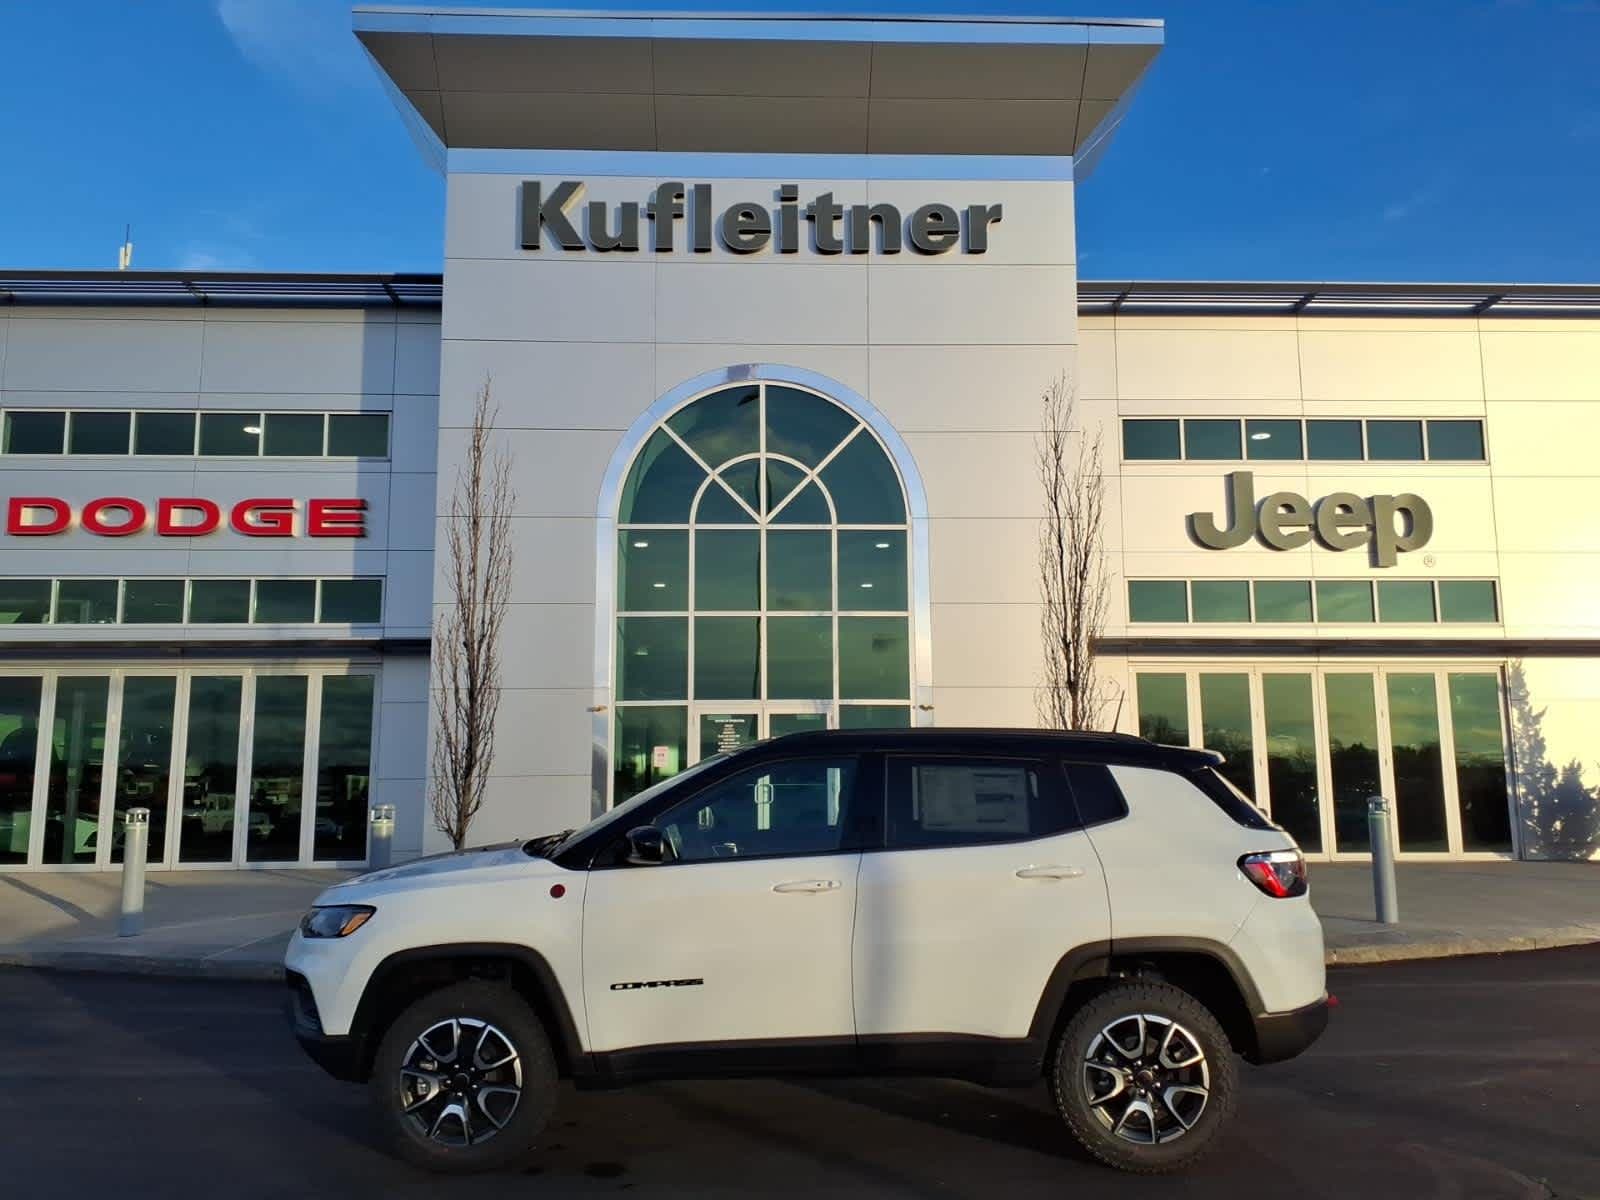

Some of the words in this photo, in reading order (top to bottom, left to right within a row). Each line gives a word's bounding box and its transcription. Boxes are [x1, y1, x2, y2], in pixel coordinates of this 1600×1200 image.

[518, 180, 1004, 256] Kufleitner
[6, 496, 368, 537] DODGE
[1185, 471, 1433, 568] Jeep
